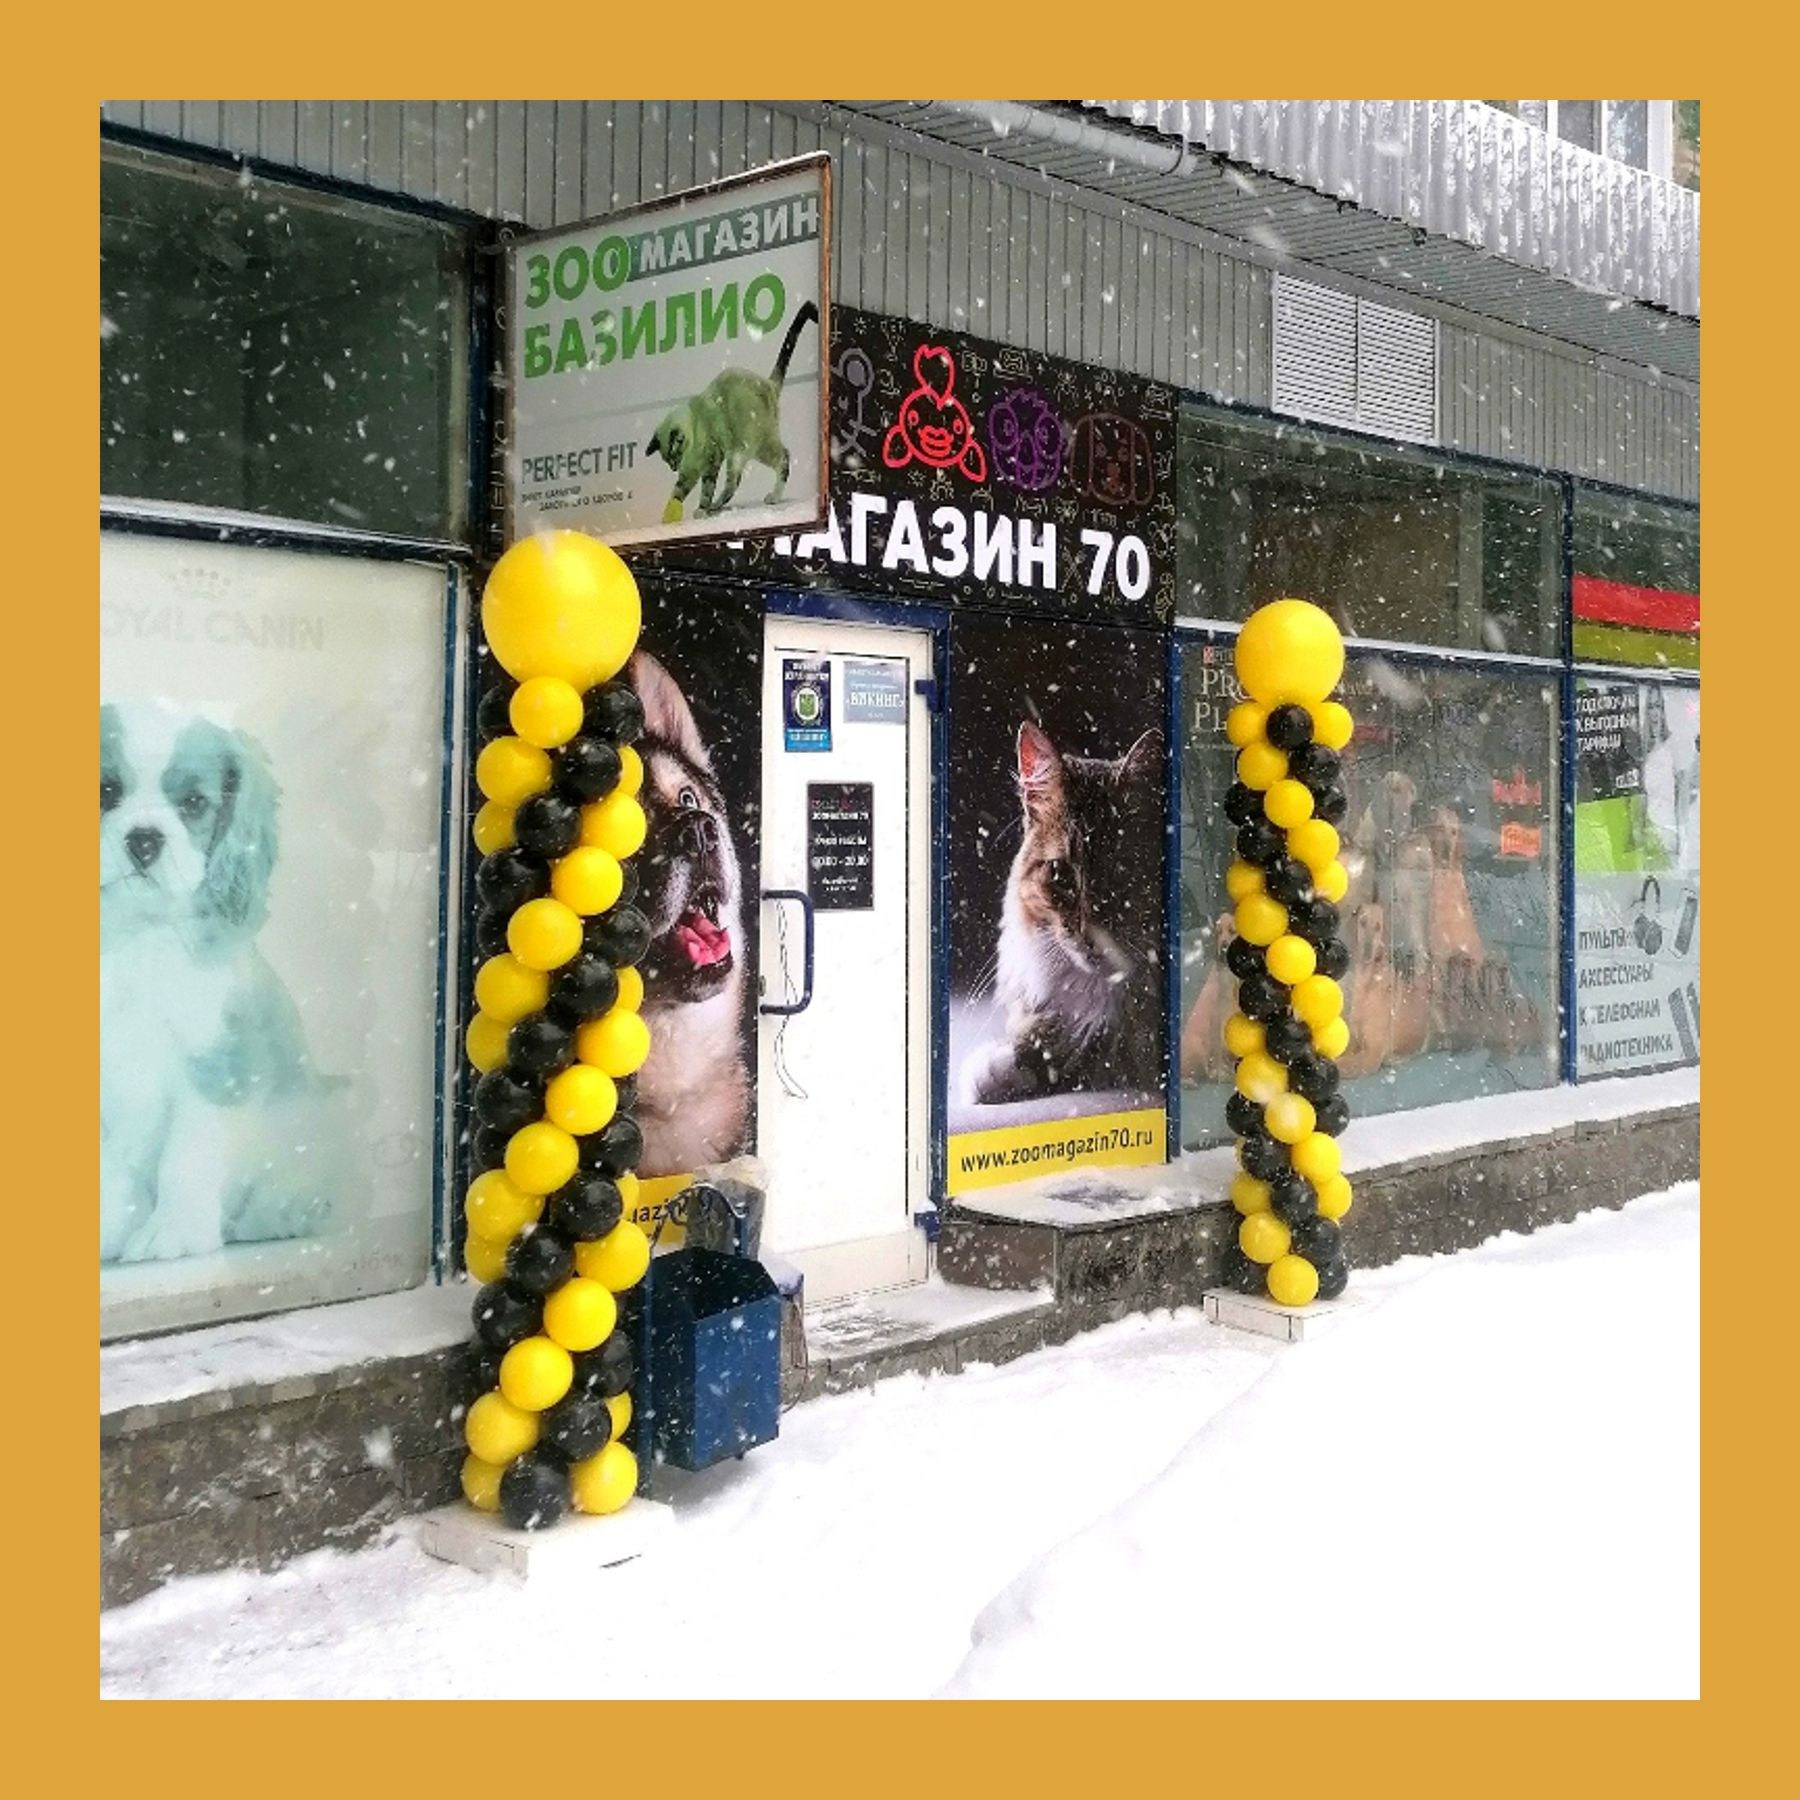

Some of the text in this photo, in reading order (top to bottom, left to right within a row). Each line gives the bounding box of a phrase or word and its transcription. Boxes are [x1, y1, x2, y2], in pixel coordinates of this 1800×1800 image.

[524, 273, 786, 378] БАЗИЛИО
[522, 441, 638, 484] PERFECT FIT
[1080, 529, 1151, 601] 70
[961, 1127, 1153, 1173] www.zoomagazin70.ru
